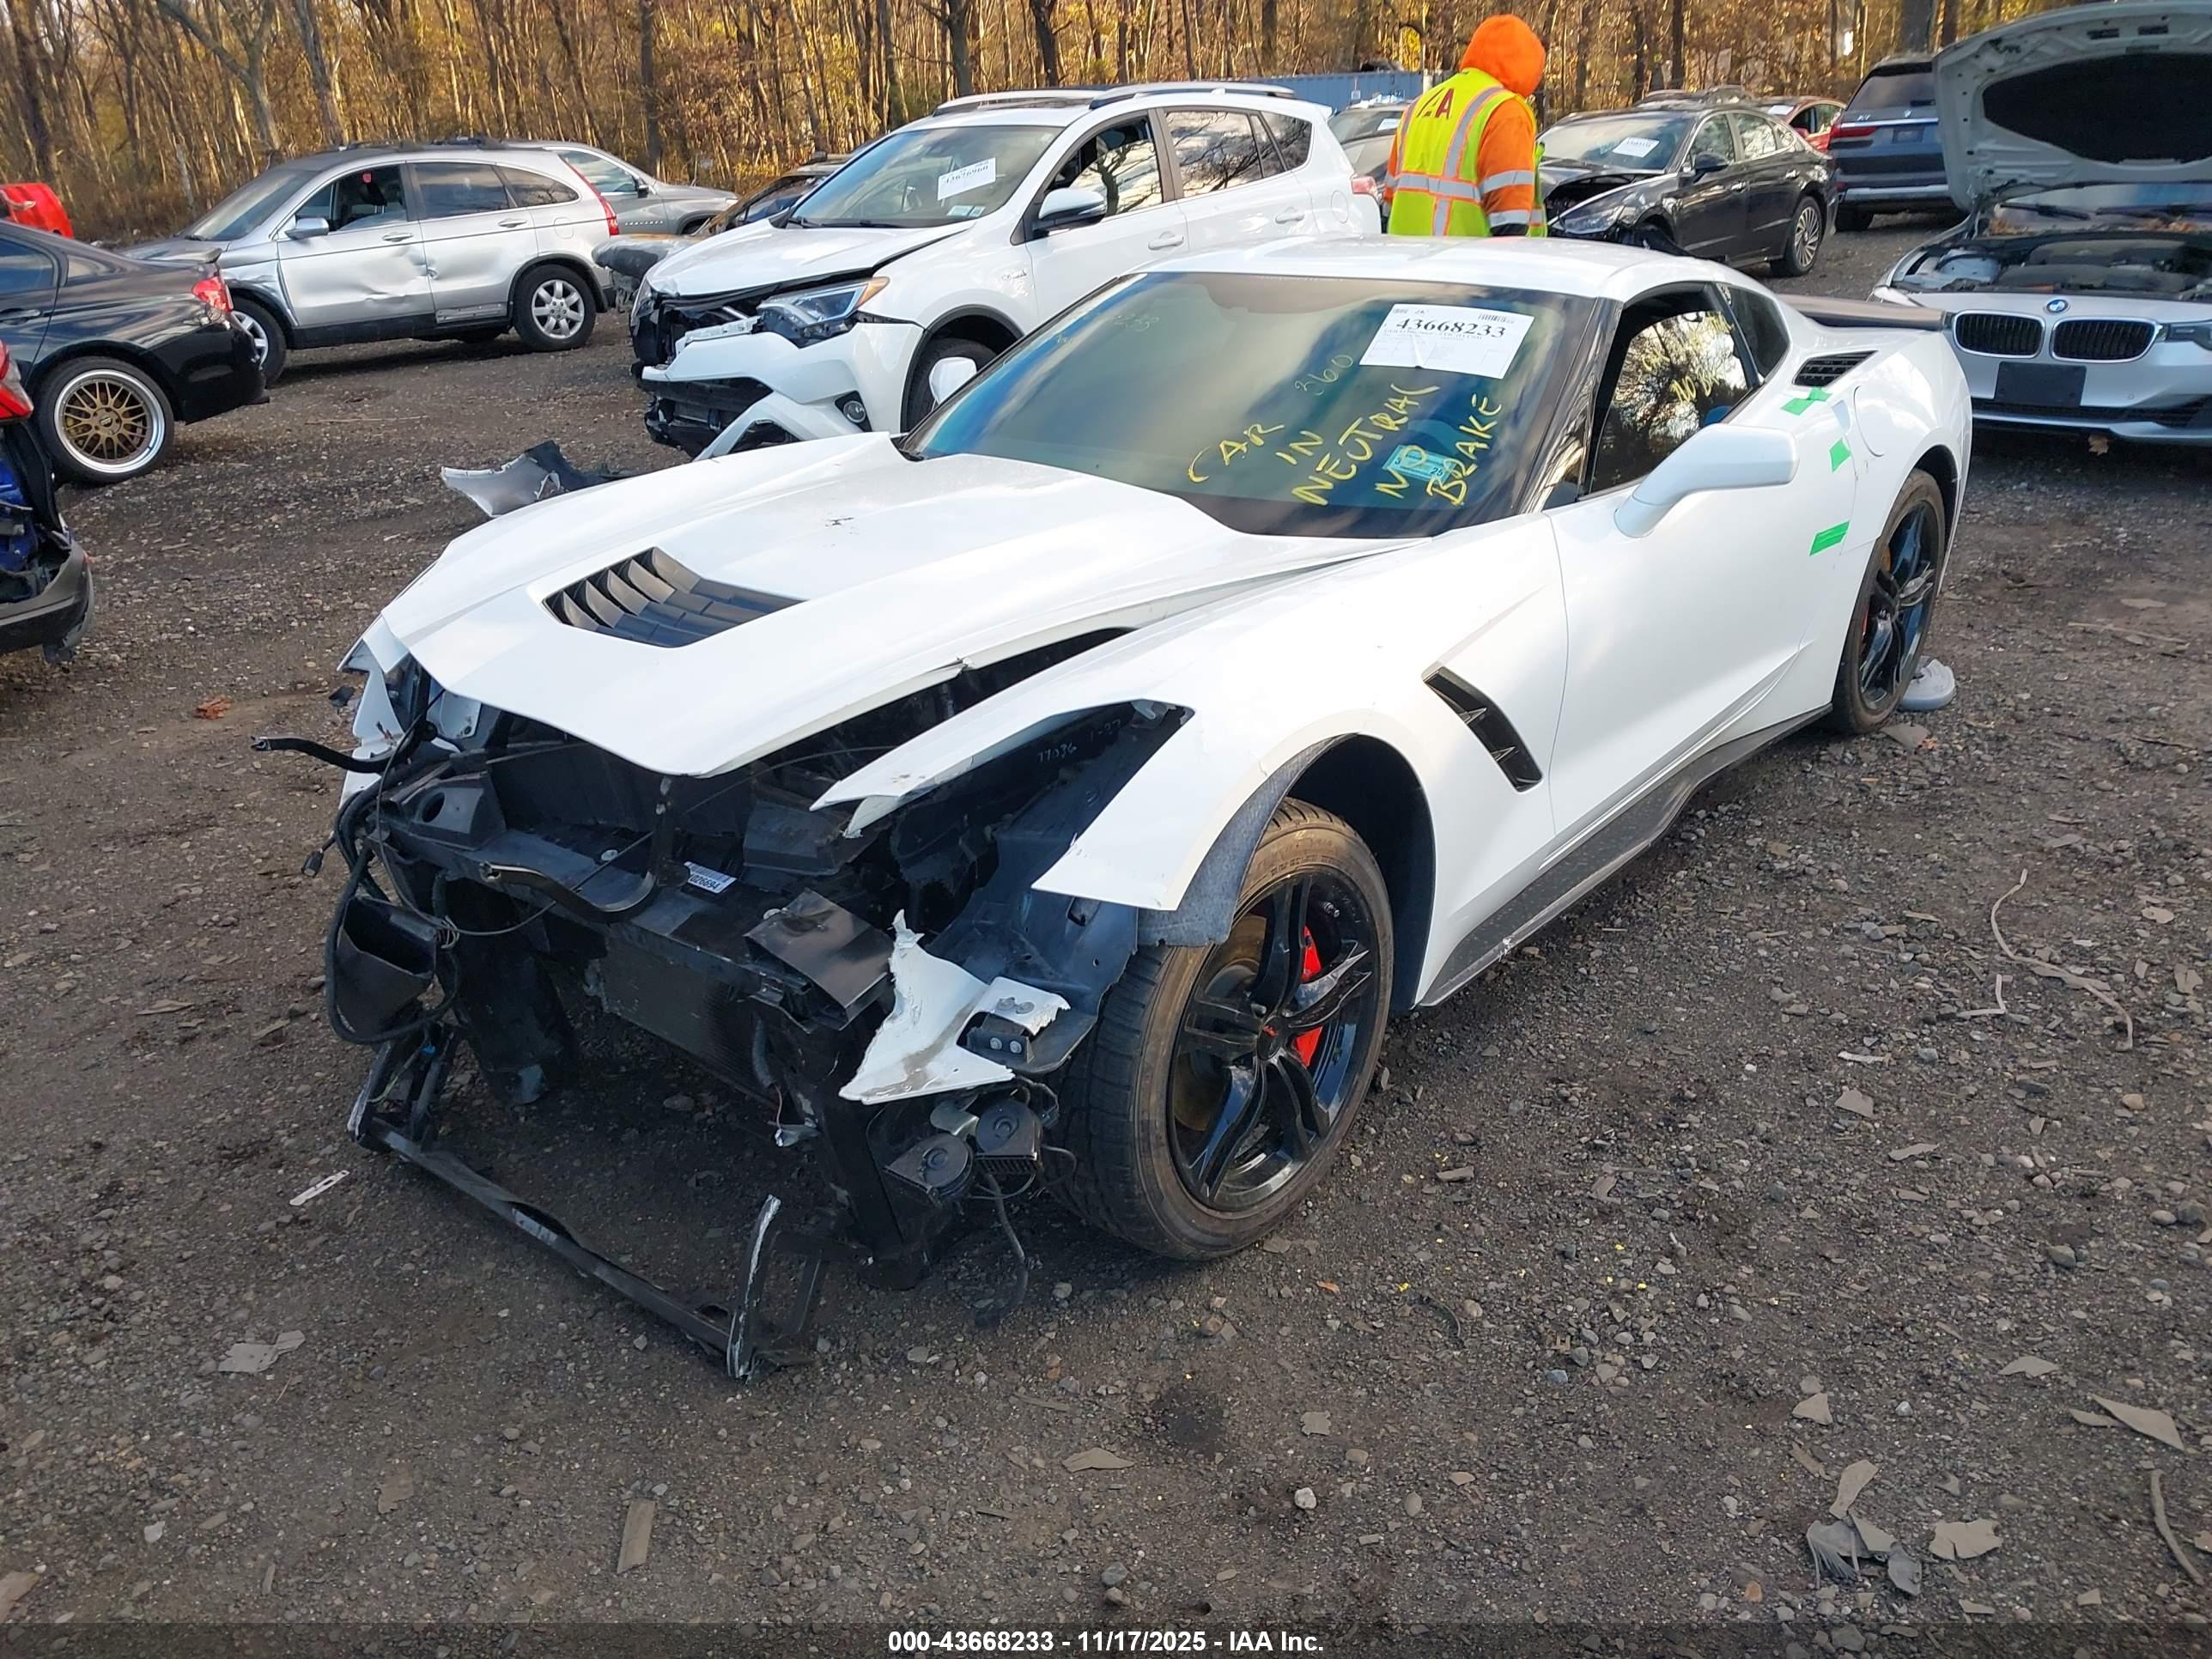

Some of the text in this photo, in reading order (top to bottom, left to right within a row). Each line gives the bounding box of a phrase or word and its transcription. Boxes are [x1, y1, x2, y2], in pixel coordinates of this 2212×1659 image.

[1395, 318, 1506, 338] 43668233
[1188, 424, 1285, 483] CAR
[1276, 430, 1323, 465] IN
[1291, 383, 1441, 506] NEUTRAL
[1426, 393, 1502, 507] BRAKE
